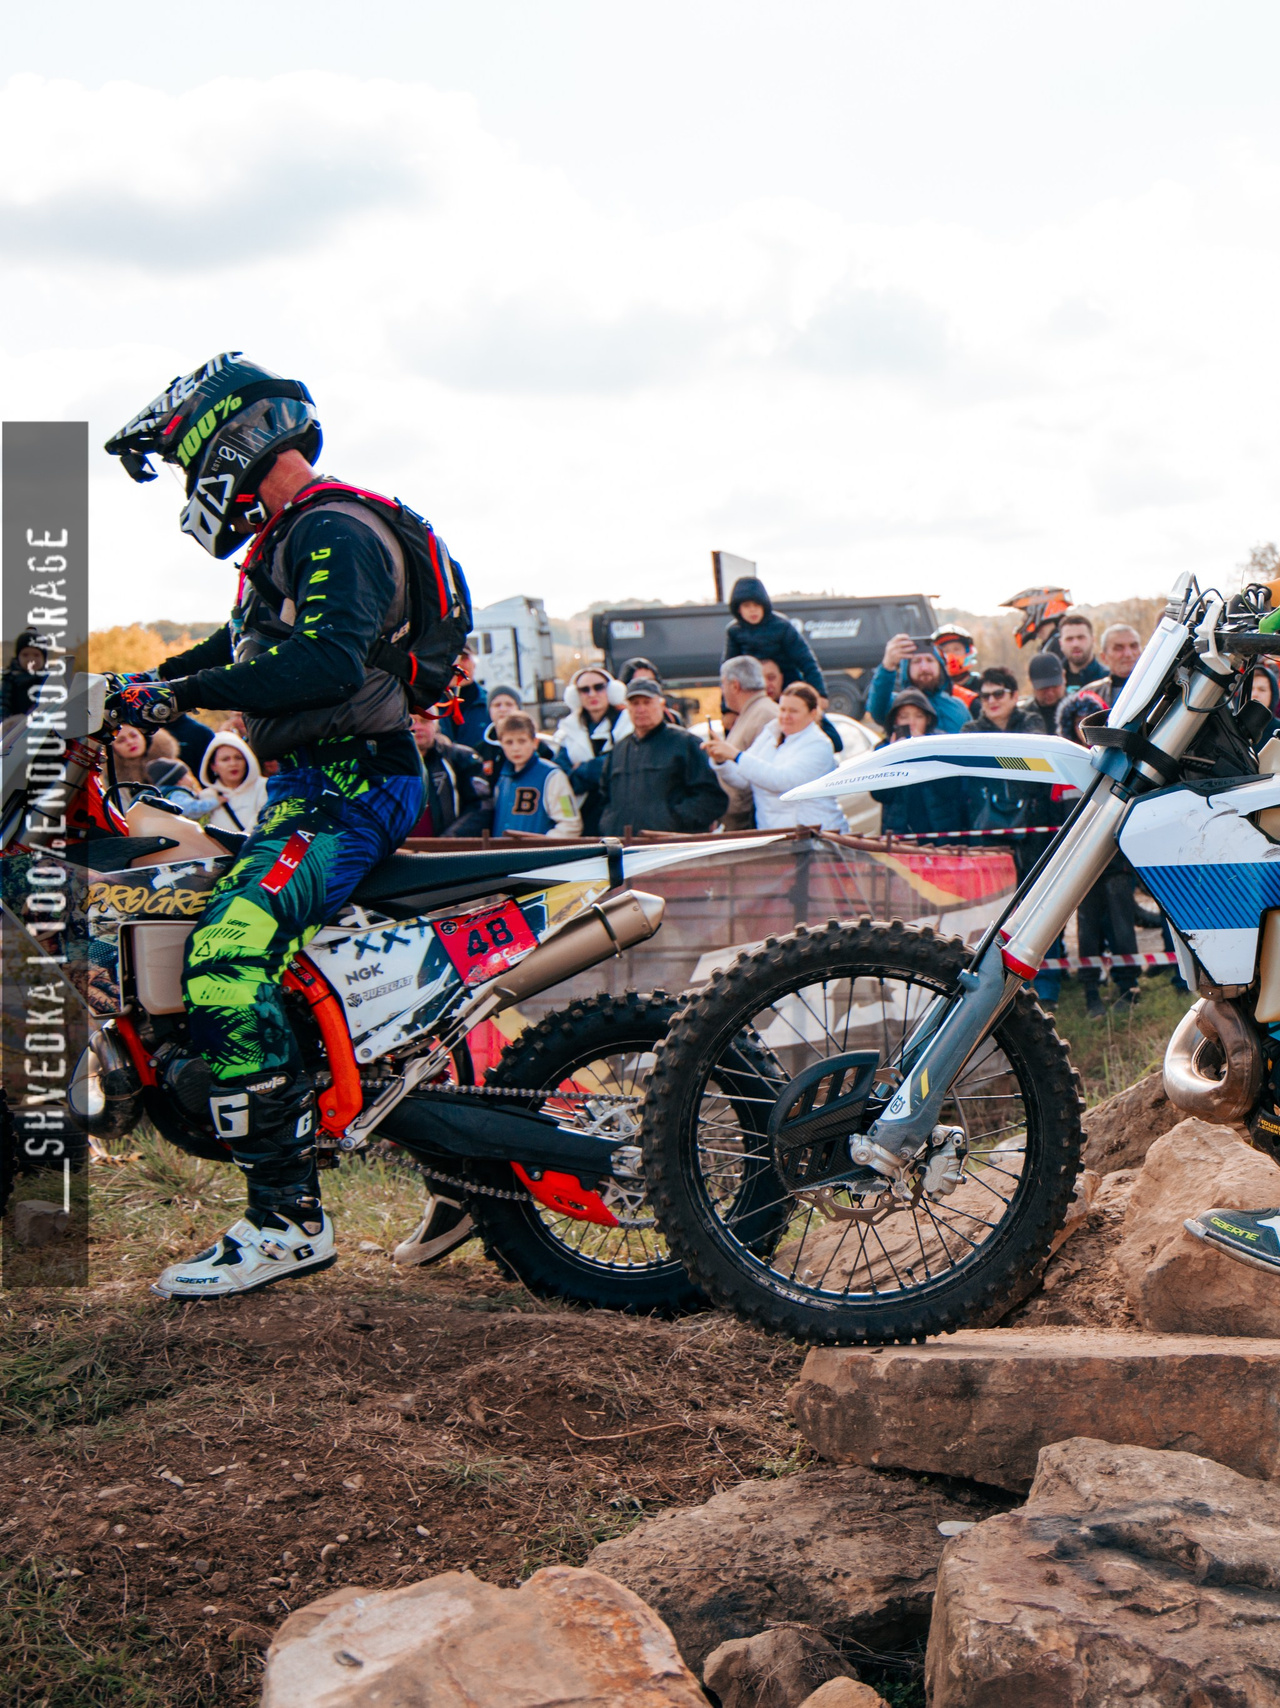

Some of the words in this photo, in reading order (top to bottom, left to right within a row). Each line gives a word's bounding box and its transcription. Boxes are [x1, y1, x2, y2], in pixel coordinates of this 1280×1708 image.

[176, 394, 243, 468] 100%
[512, 787, 539, 814] B
[466, 917, 514, 958] 48
[345, 962, 384, 985] NGK
[209, 1092, 249, 1138] G
[295, 1110, 312, 1138] G
[1210, 1217, 1260, 1242] GAERNE
[293, 1244, 315, 1260] G
[175, 1276, 220, 1284] GAERNE
